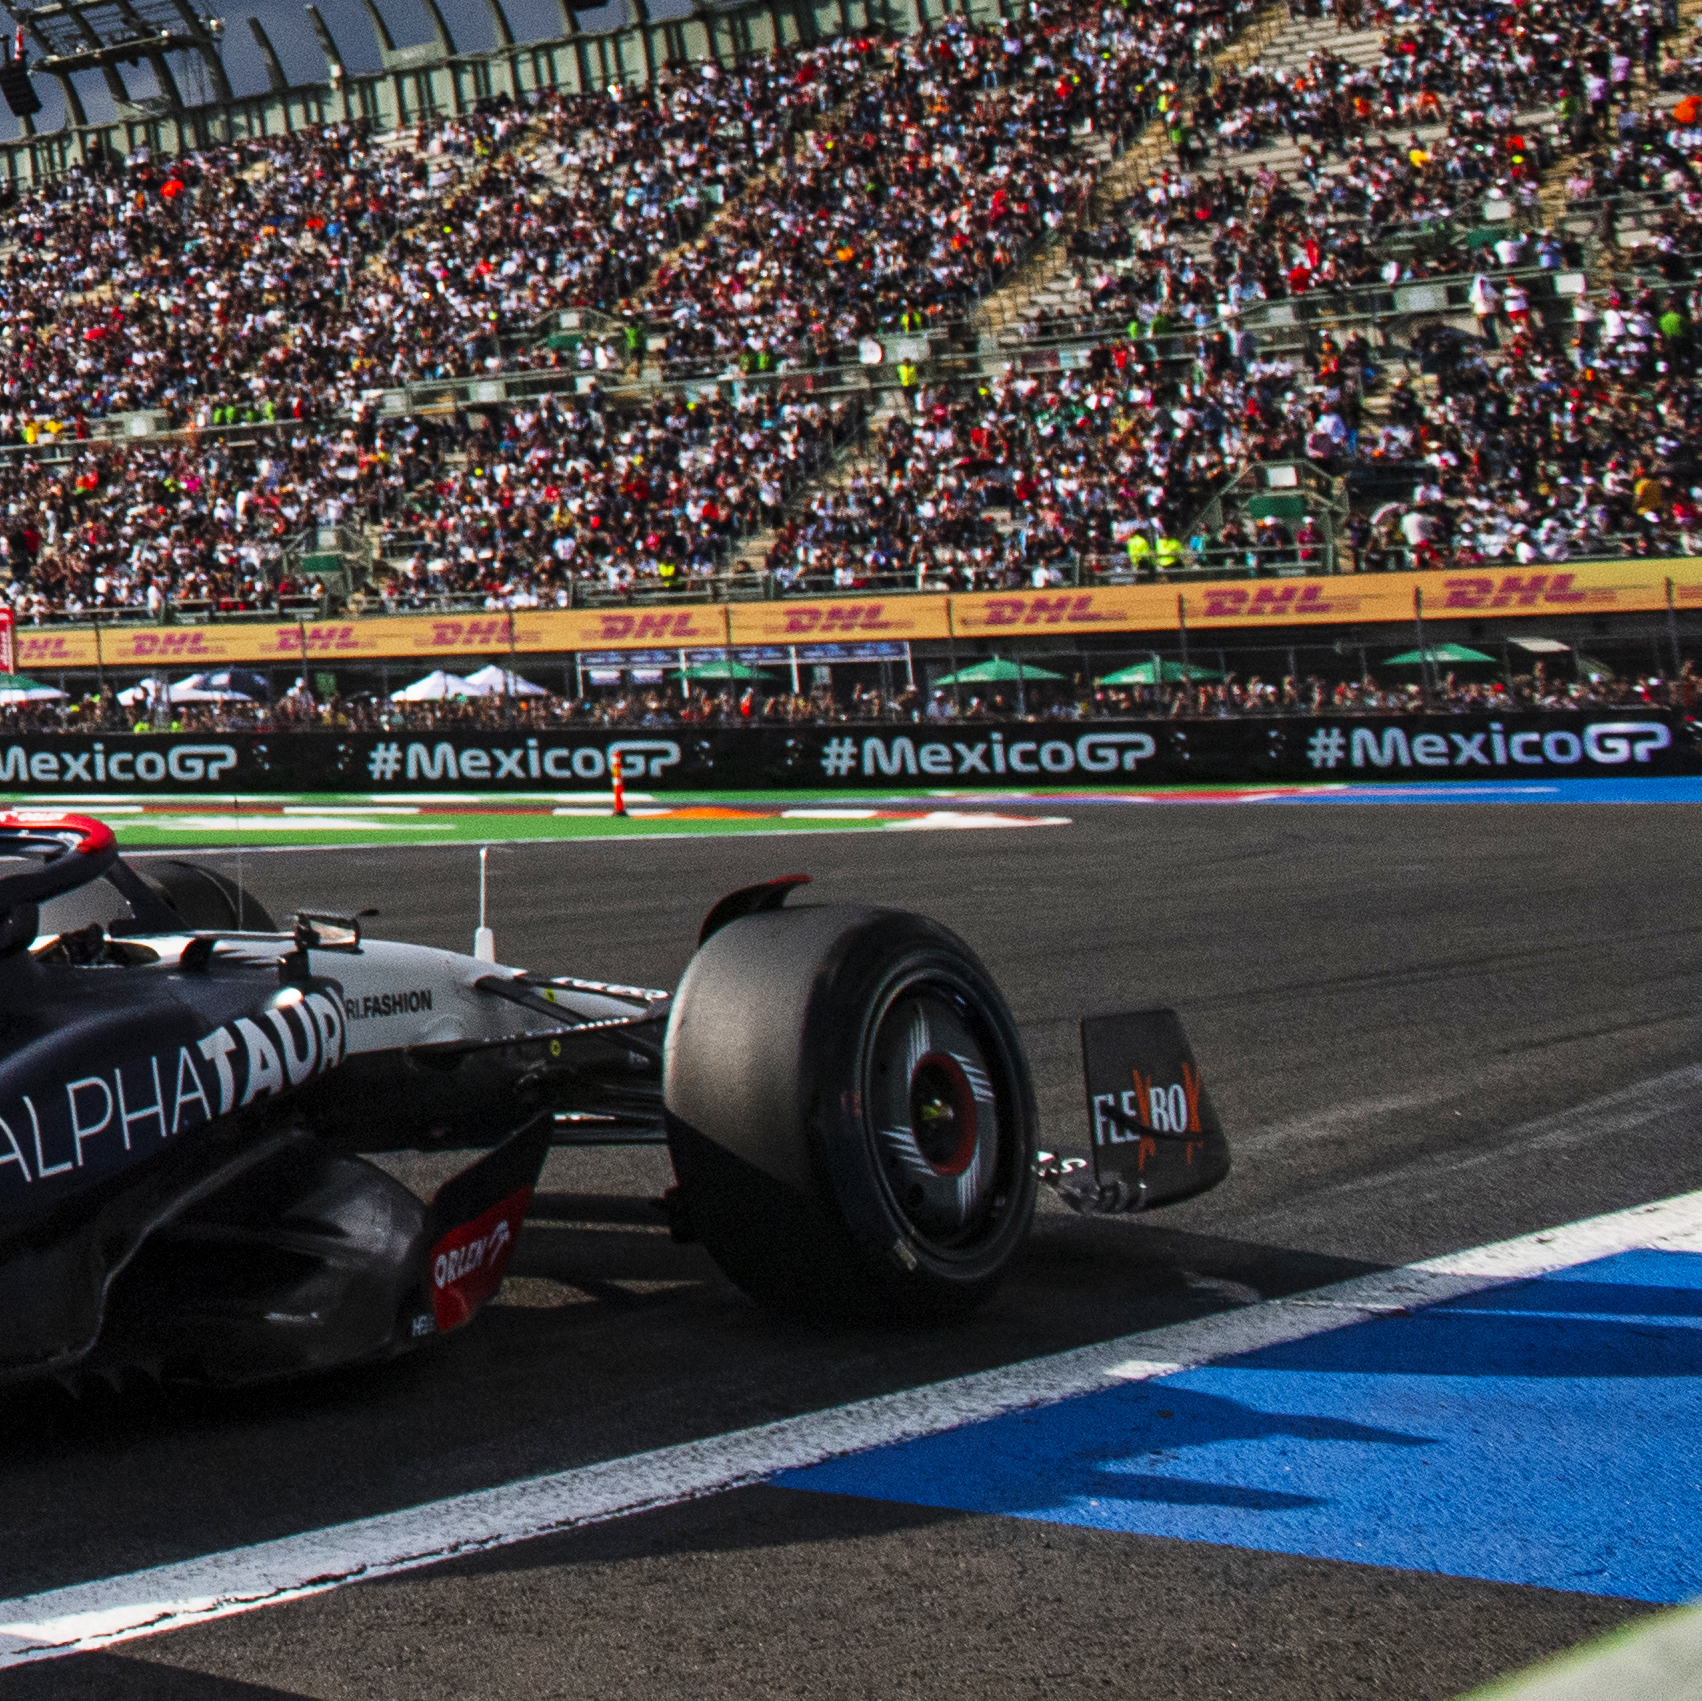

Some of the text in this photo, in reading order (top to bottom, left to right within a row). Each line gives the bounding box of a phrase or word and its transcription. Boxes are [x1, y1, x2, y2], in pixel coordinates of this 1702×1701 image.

[1203, 586, 1333, 617] DHL
[1443, 574, 1587, 609] DHL
[782, 604, 890, 634] DHL
[983, 596, 1099, 626] DHL
[276, 628, 360, 652] DHL
[431, 621, 520, 646] DHL
[600, 613, 698, 640] DHL
[132, 633, 208, 656] DHL
[368, 738, 681, 781] #MexicoGP
[820, 732, 1156, 777] #MexicoGP
[1306, 722, 1672, 769] #MexicoGP
